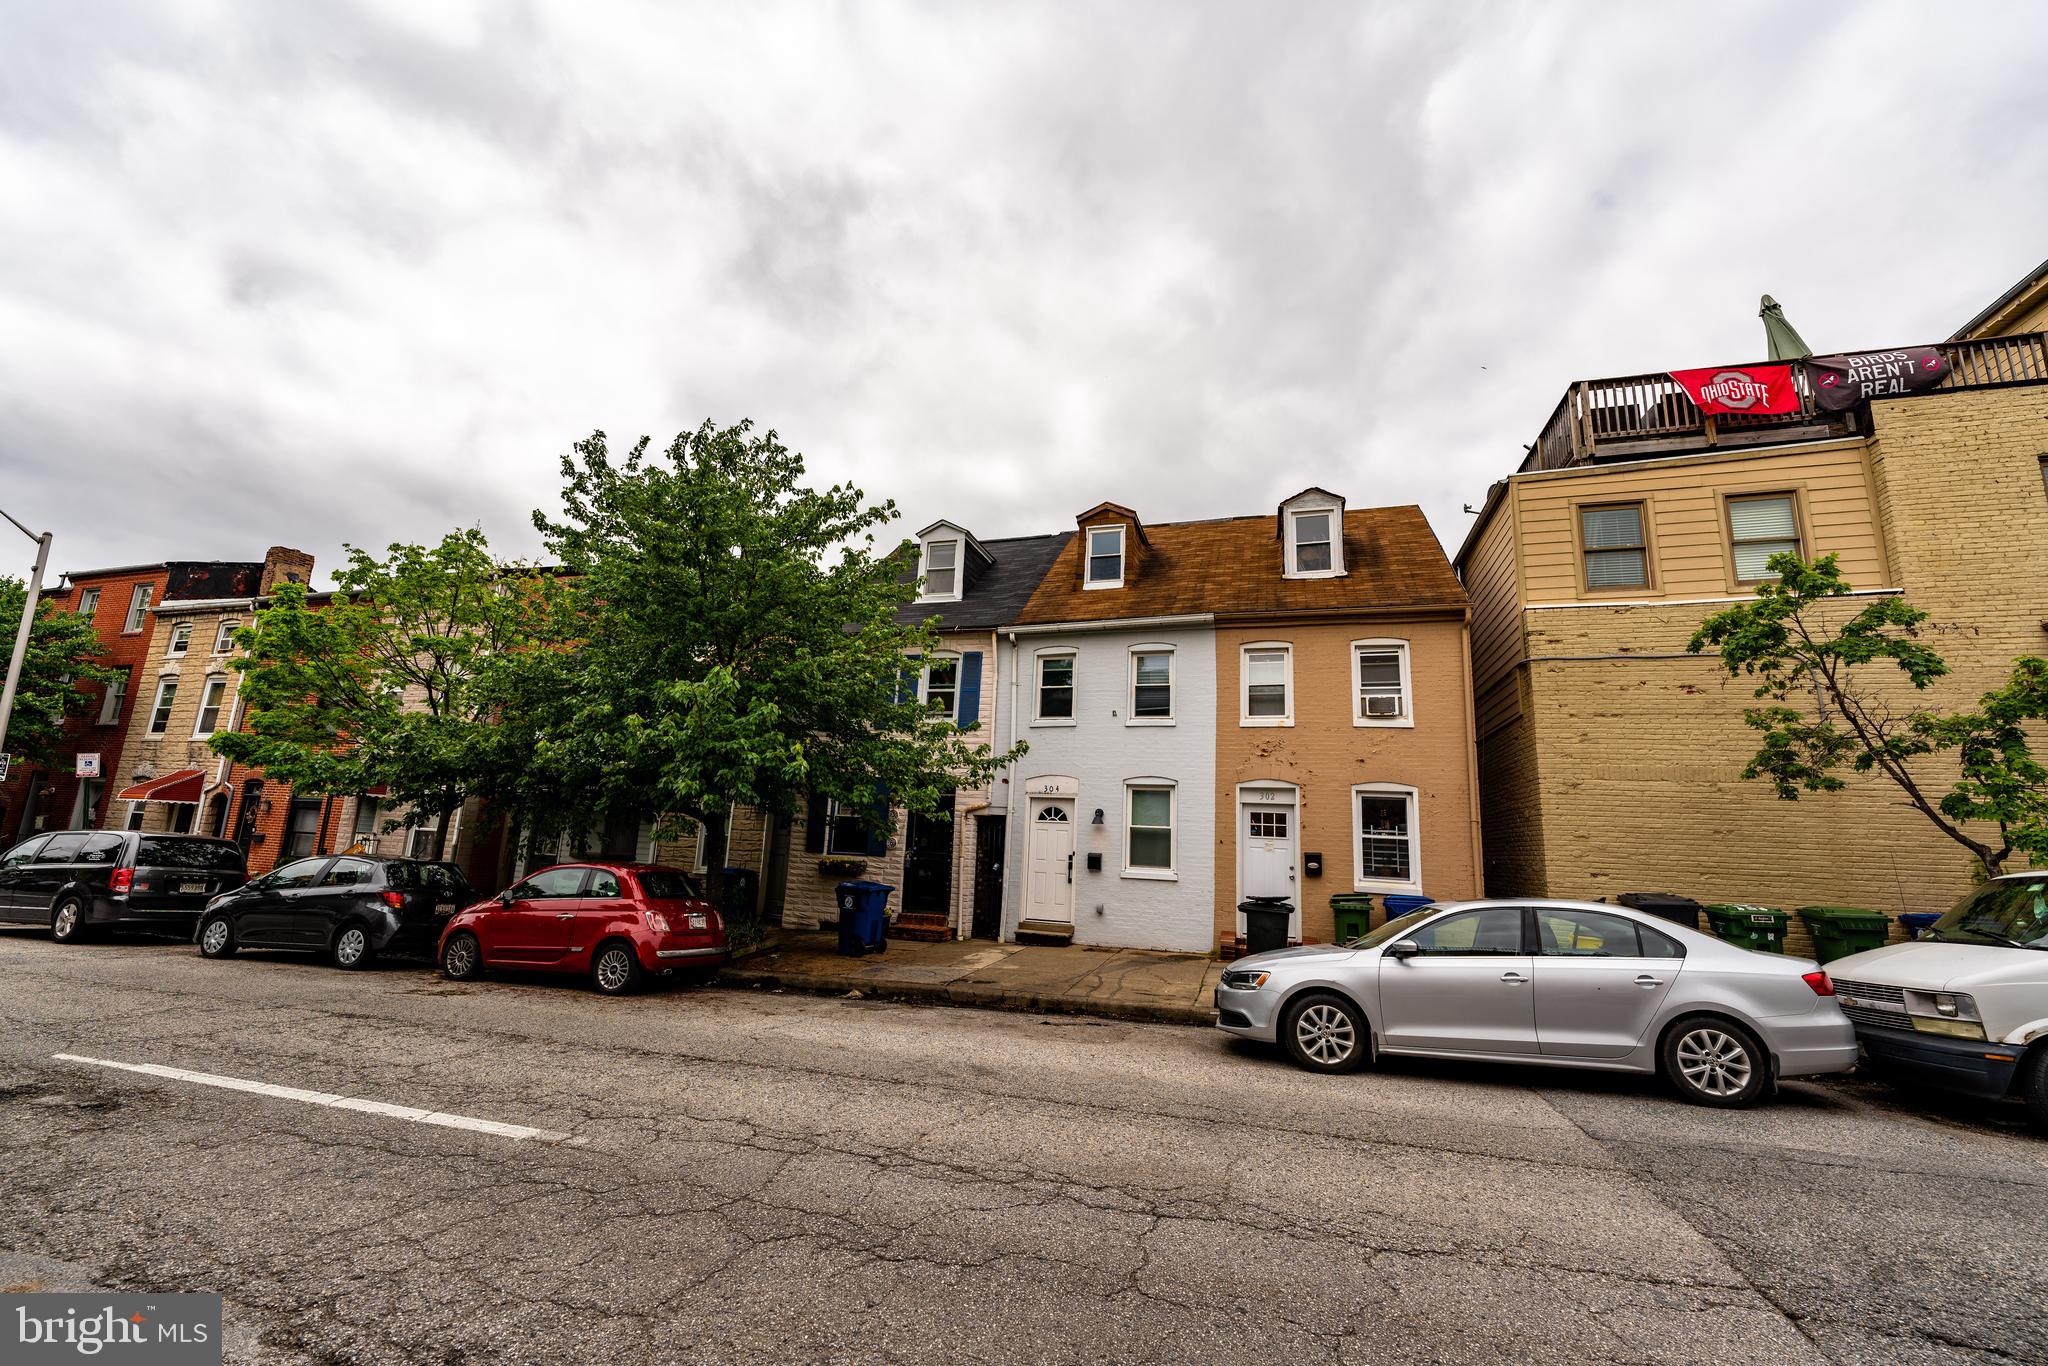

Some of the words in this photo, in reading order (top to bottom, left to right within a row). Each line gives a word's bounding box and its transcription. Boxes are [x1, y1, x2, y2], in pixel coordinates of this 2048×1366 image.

[1847, 351, 1908, 368] BIRDS
[1847, 360, 1915, 384] AREN'T
[1860, 377, 1911, 399] REAL
[1043, 784, 1060, 793] 304
[1258, 791, 1276, 801] 302
